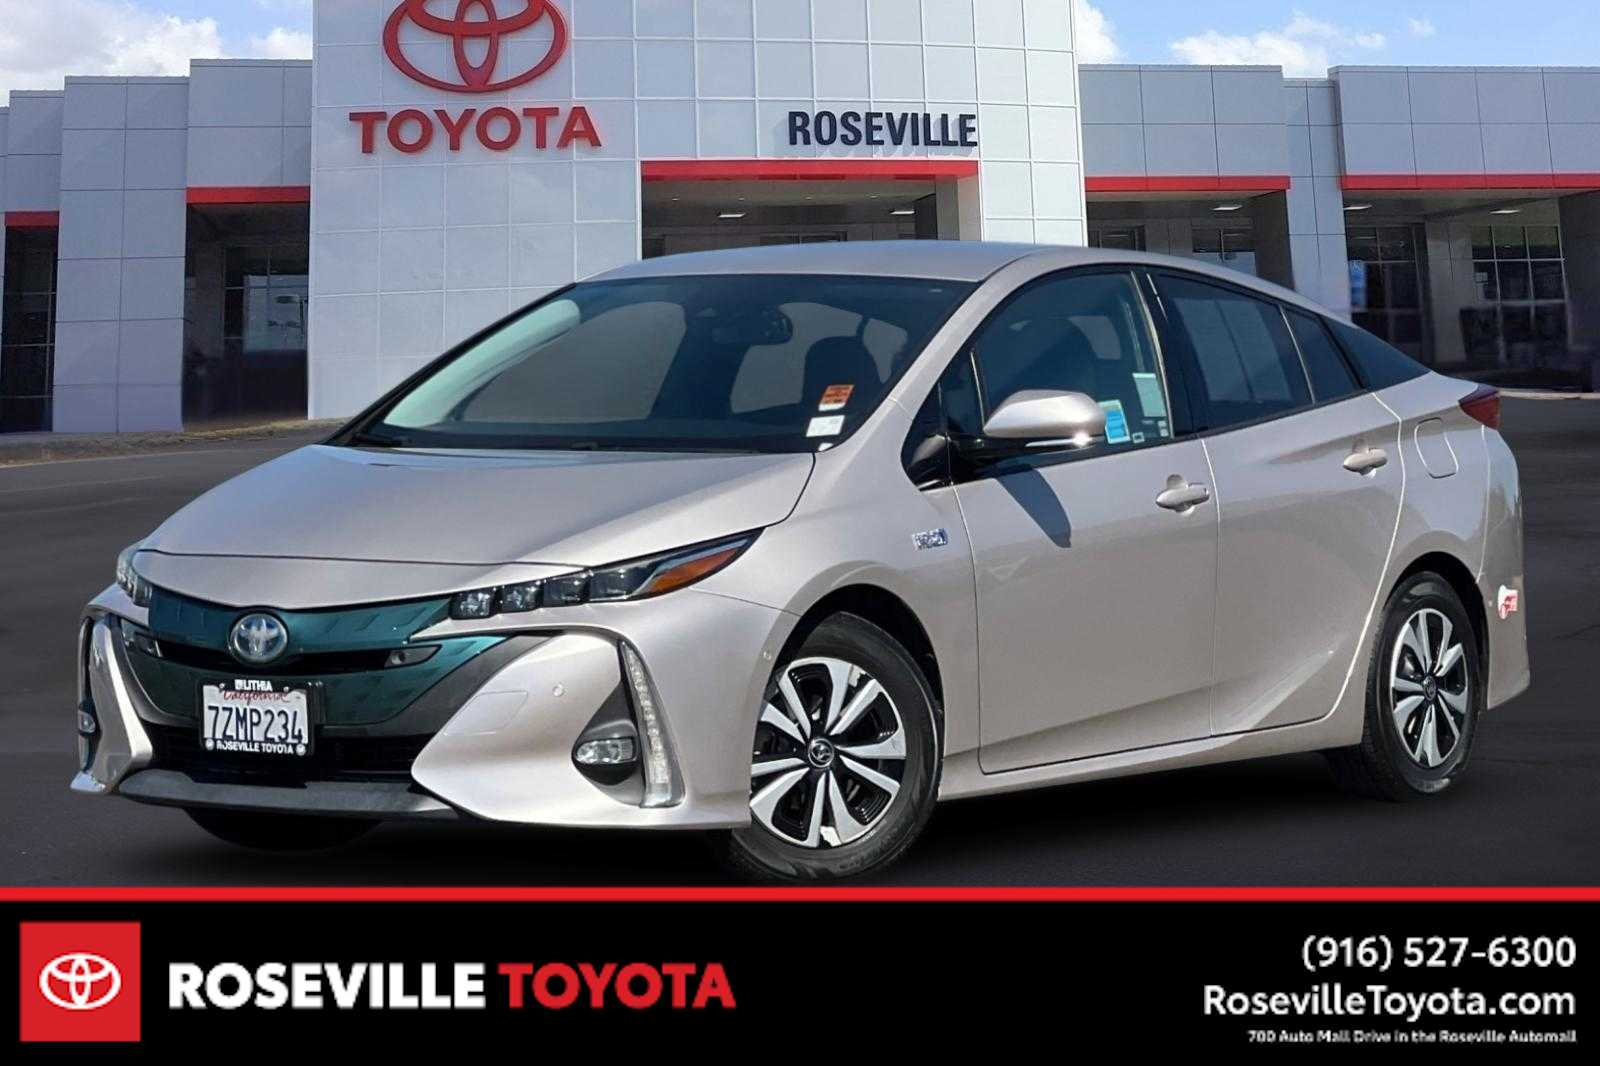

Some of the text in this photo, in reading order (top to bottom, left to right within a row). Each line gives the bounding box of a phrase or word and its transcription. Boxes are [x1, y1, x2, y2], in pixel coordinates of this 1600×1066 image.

[349, 106, 602, 153] TOYOTA
[788, 110, 978, 147] ROSEVILLE
[243, 680, 273, 692] LITHIA
[207, 705, 303, 742] 7ZMP234
[216, 740, 294, 754] ROSEVILLE TOYOTA
